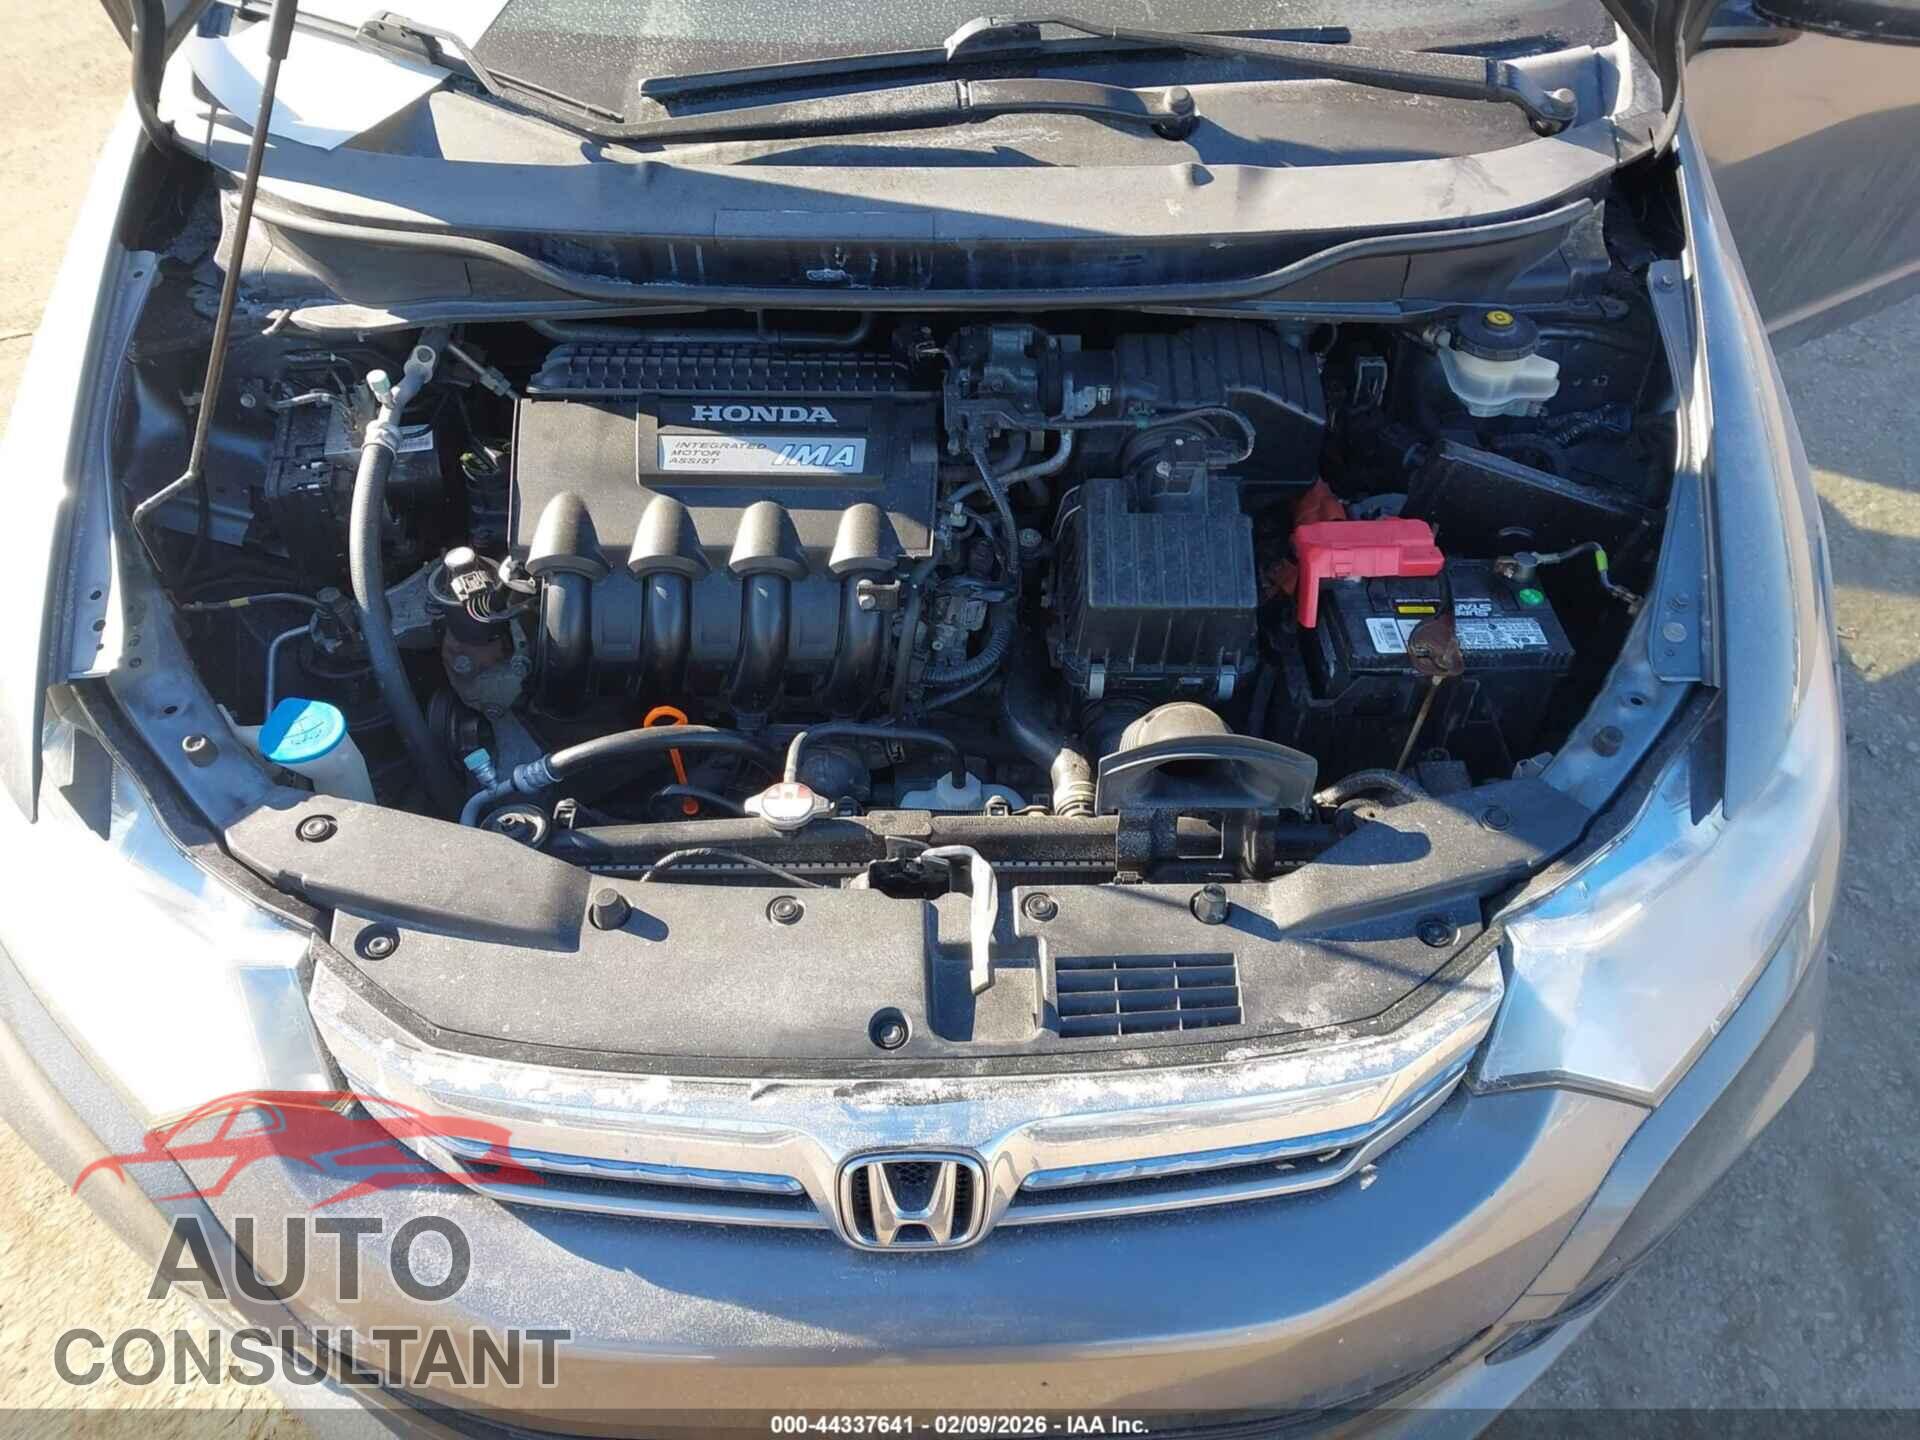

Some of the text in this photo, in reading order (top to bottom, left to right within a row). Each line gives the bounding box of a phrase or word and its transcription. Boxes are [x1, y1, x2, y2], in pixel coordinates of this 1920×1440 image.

[691, 405, 837, 423] HONDA
[668, 457, 719, 465] ASSIST
[771, 443, 856, 467] IMA
